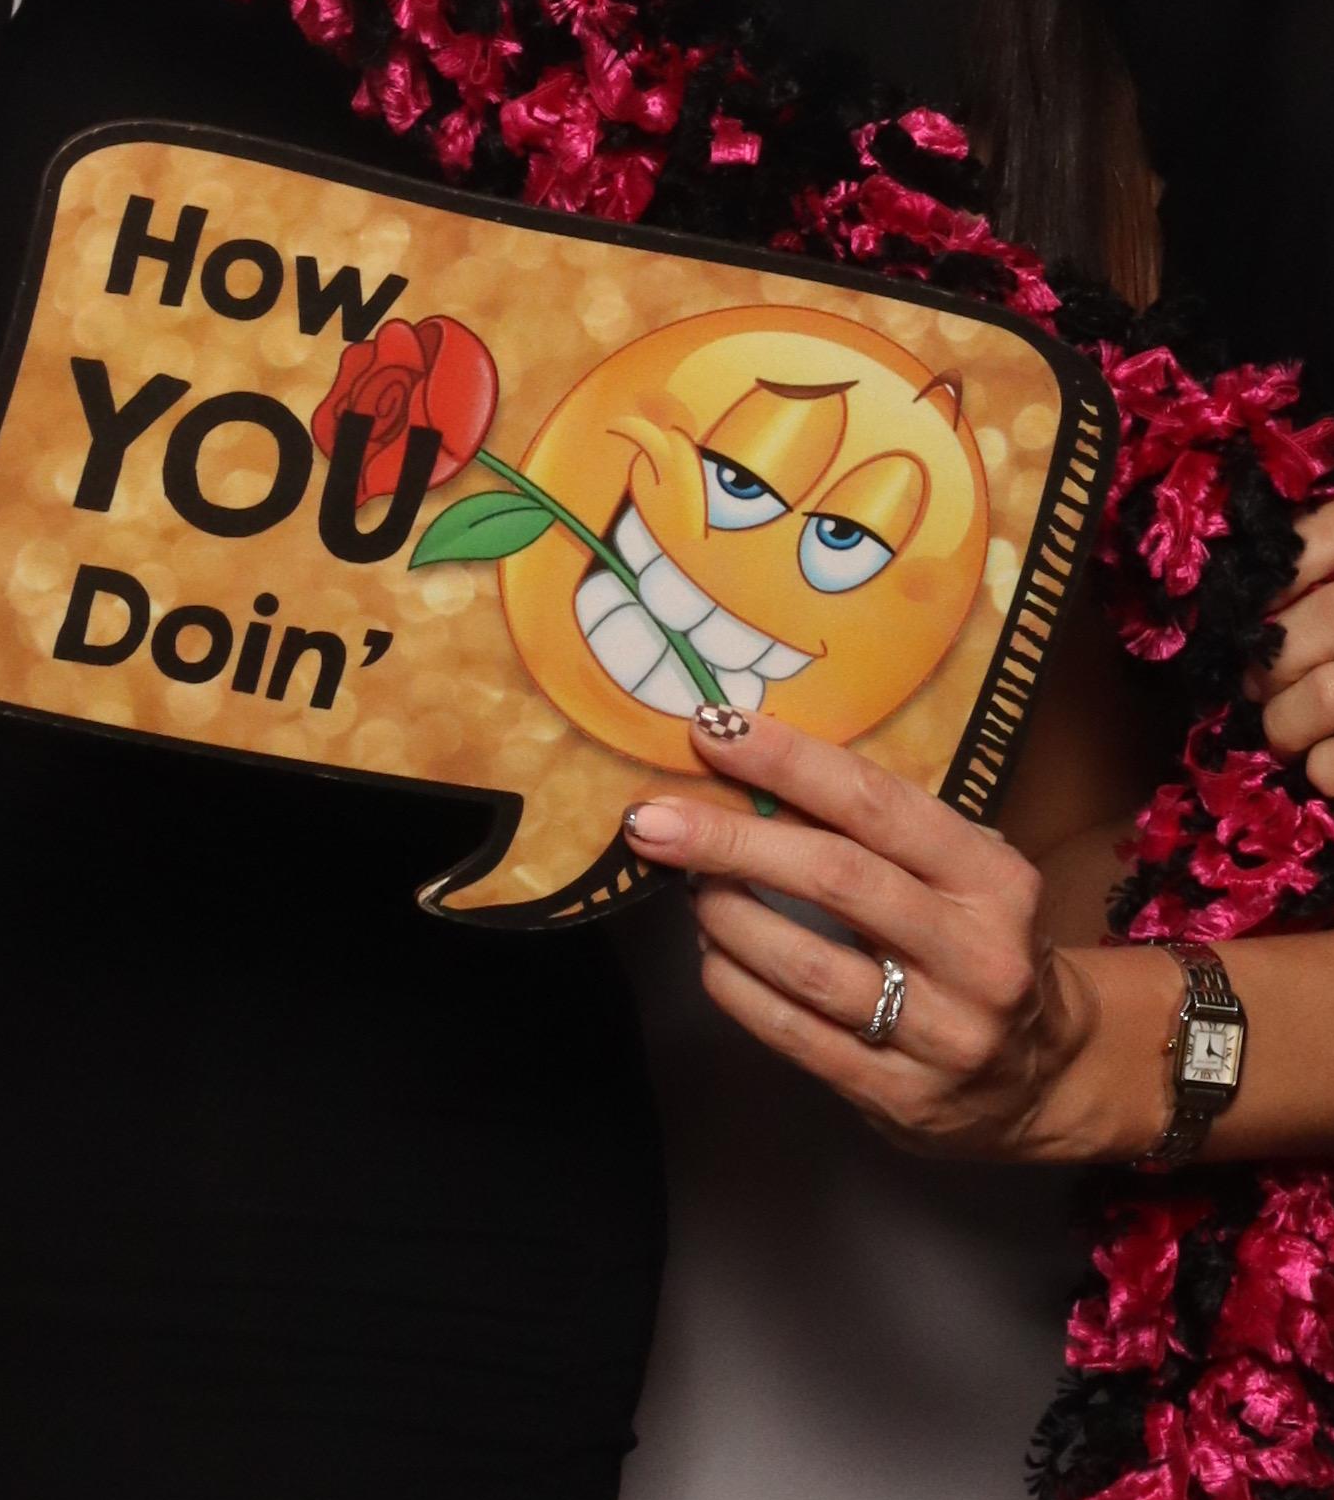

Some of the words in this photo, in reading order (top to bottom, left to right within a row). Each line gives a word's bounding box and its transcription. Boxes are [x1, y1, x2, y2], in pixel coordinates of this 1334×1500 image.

[105, 194, 409, 343] How
[70, 356, 444, 564] YOU
[53, 564, 394, 710] Doin'
